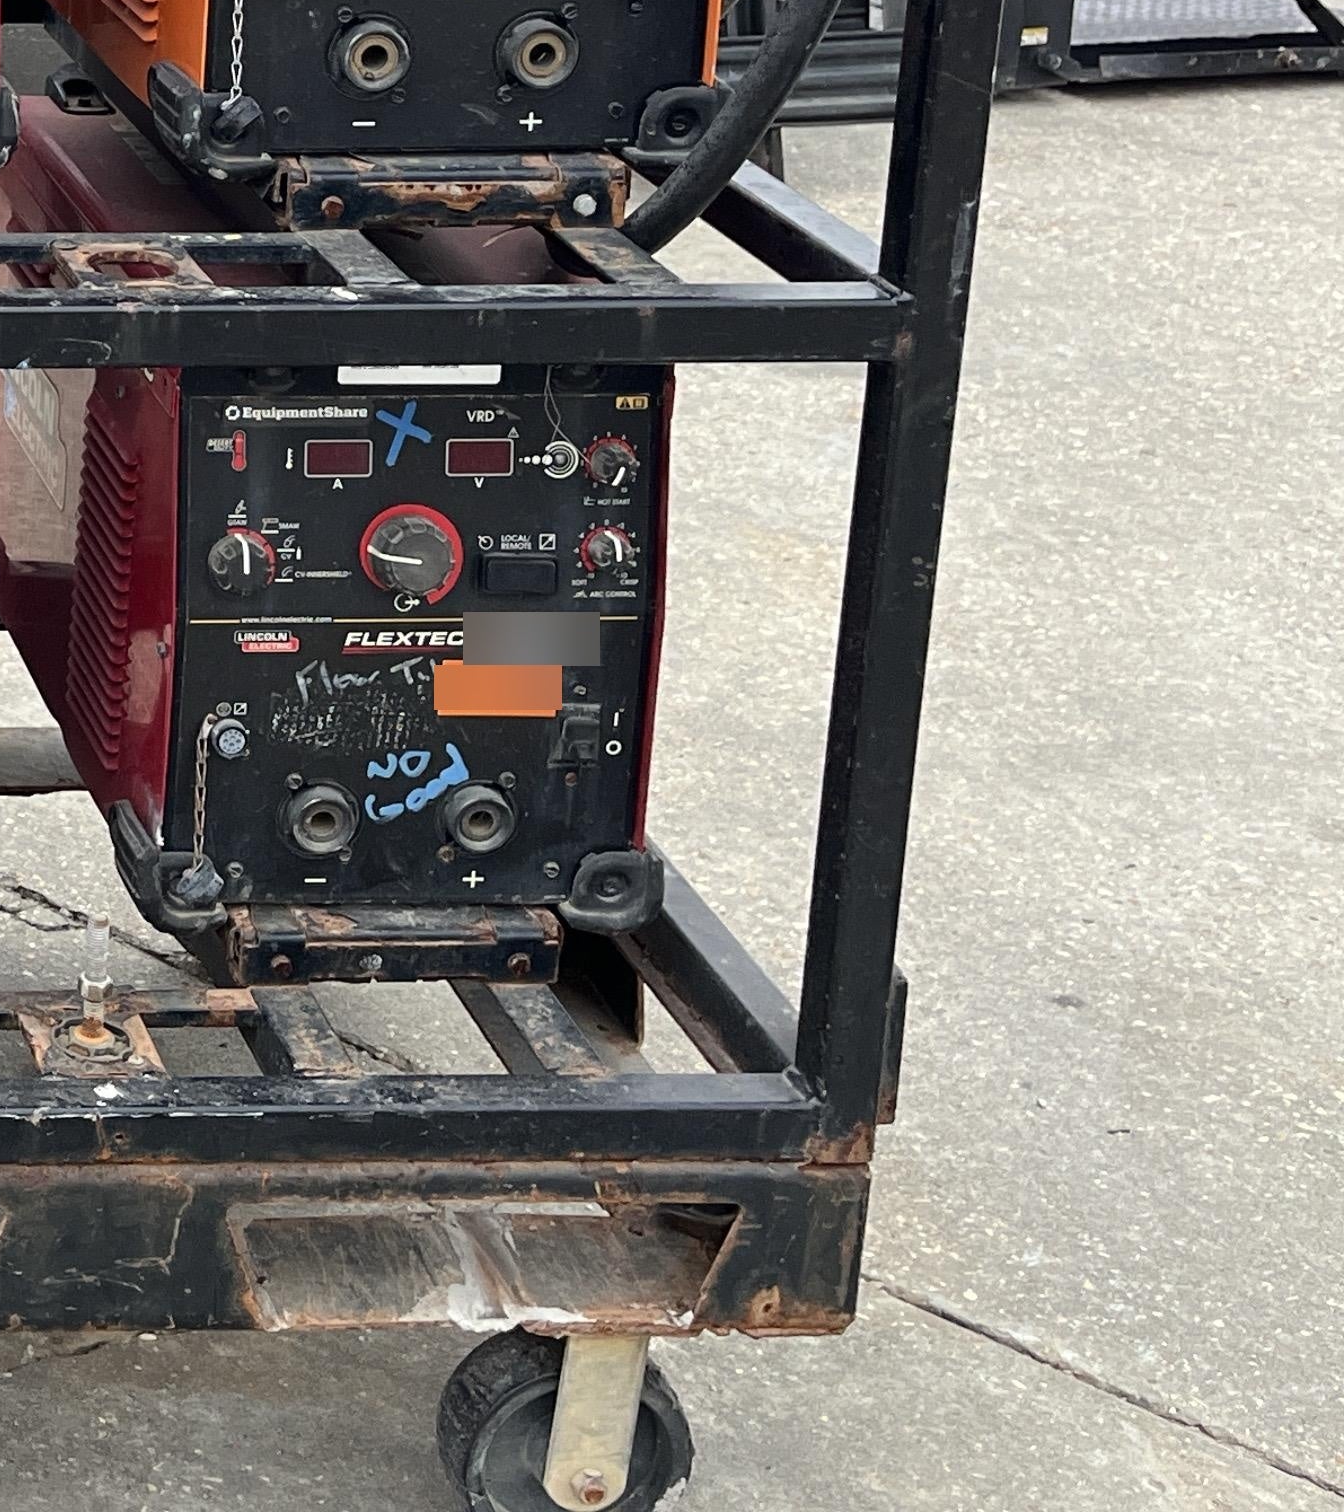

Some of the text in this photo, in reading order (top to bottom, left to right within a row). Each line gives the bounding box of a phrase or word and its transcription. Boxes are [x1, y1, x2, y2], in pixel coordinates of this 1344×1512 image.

[242, 407, 367, 420] EquipmentShare
[332, 479, 343, 490] A
[474, 477, 484, 488] V
[238, 633, 287, 641] LINCOLN
[344, 631, 464, 647] FLEXTEC
